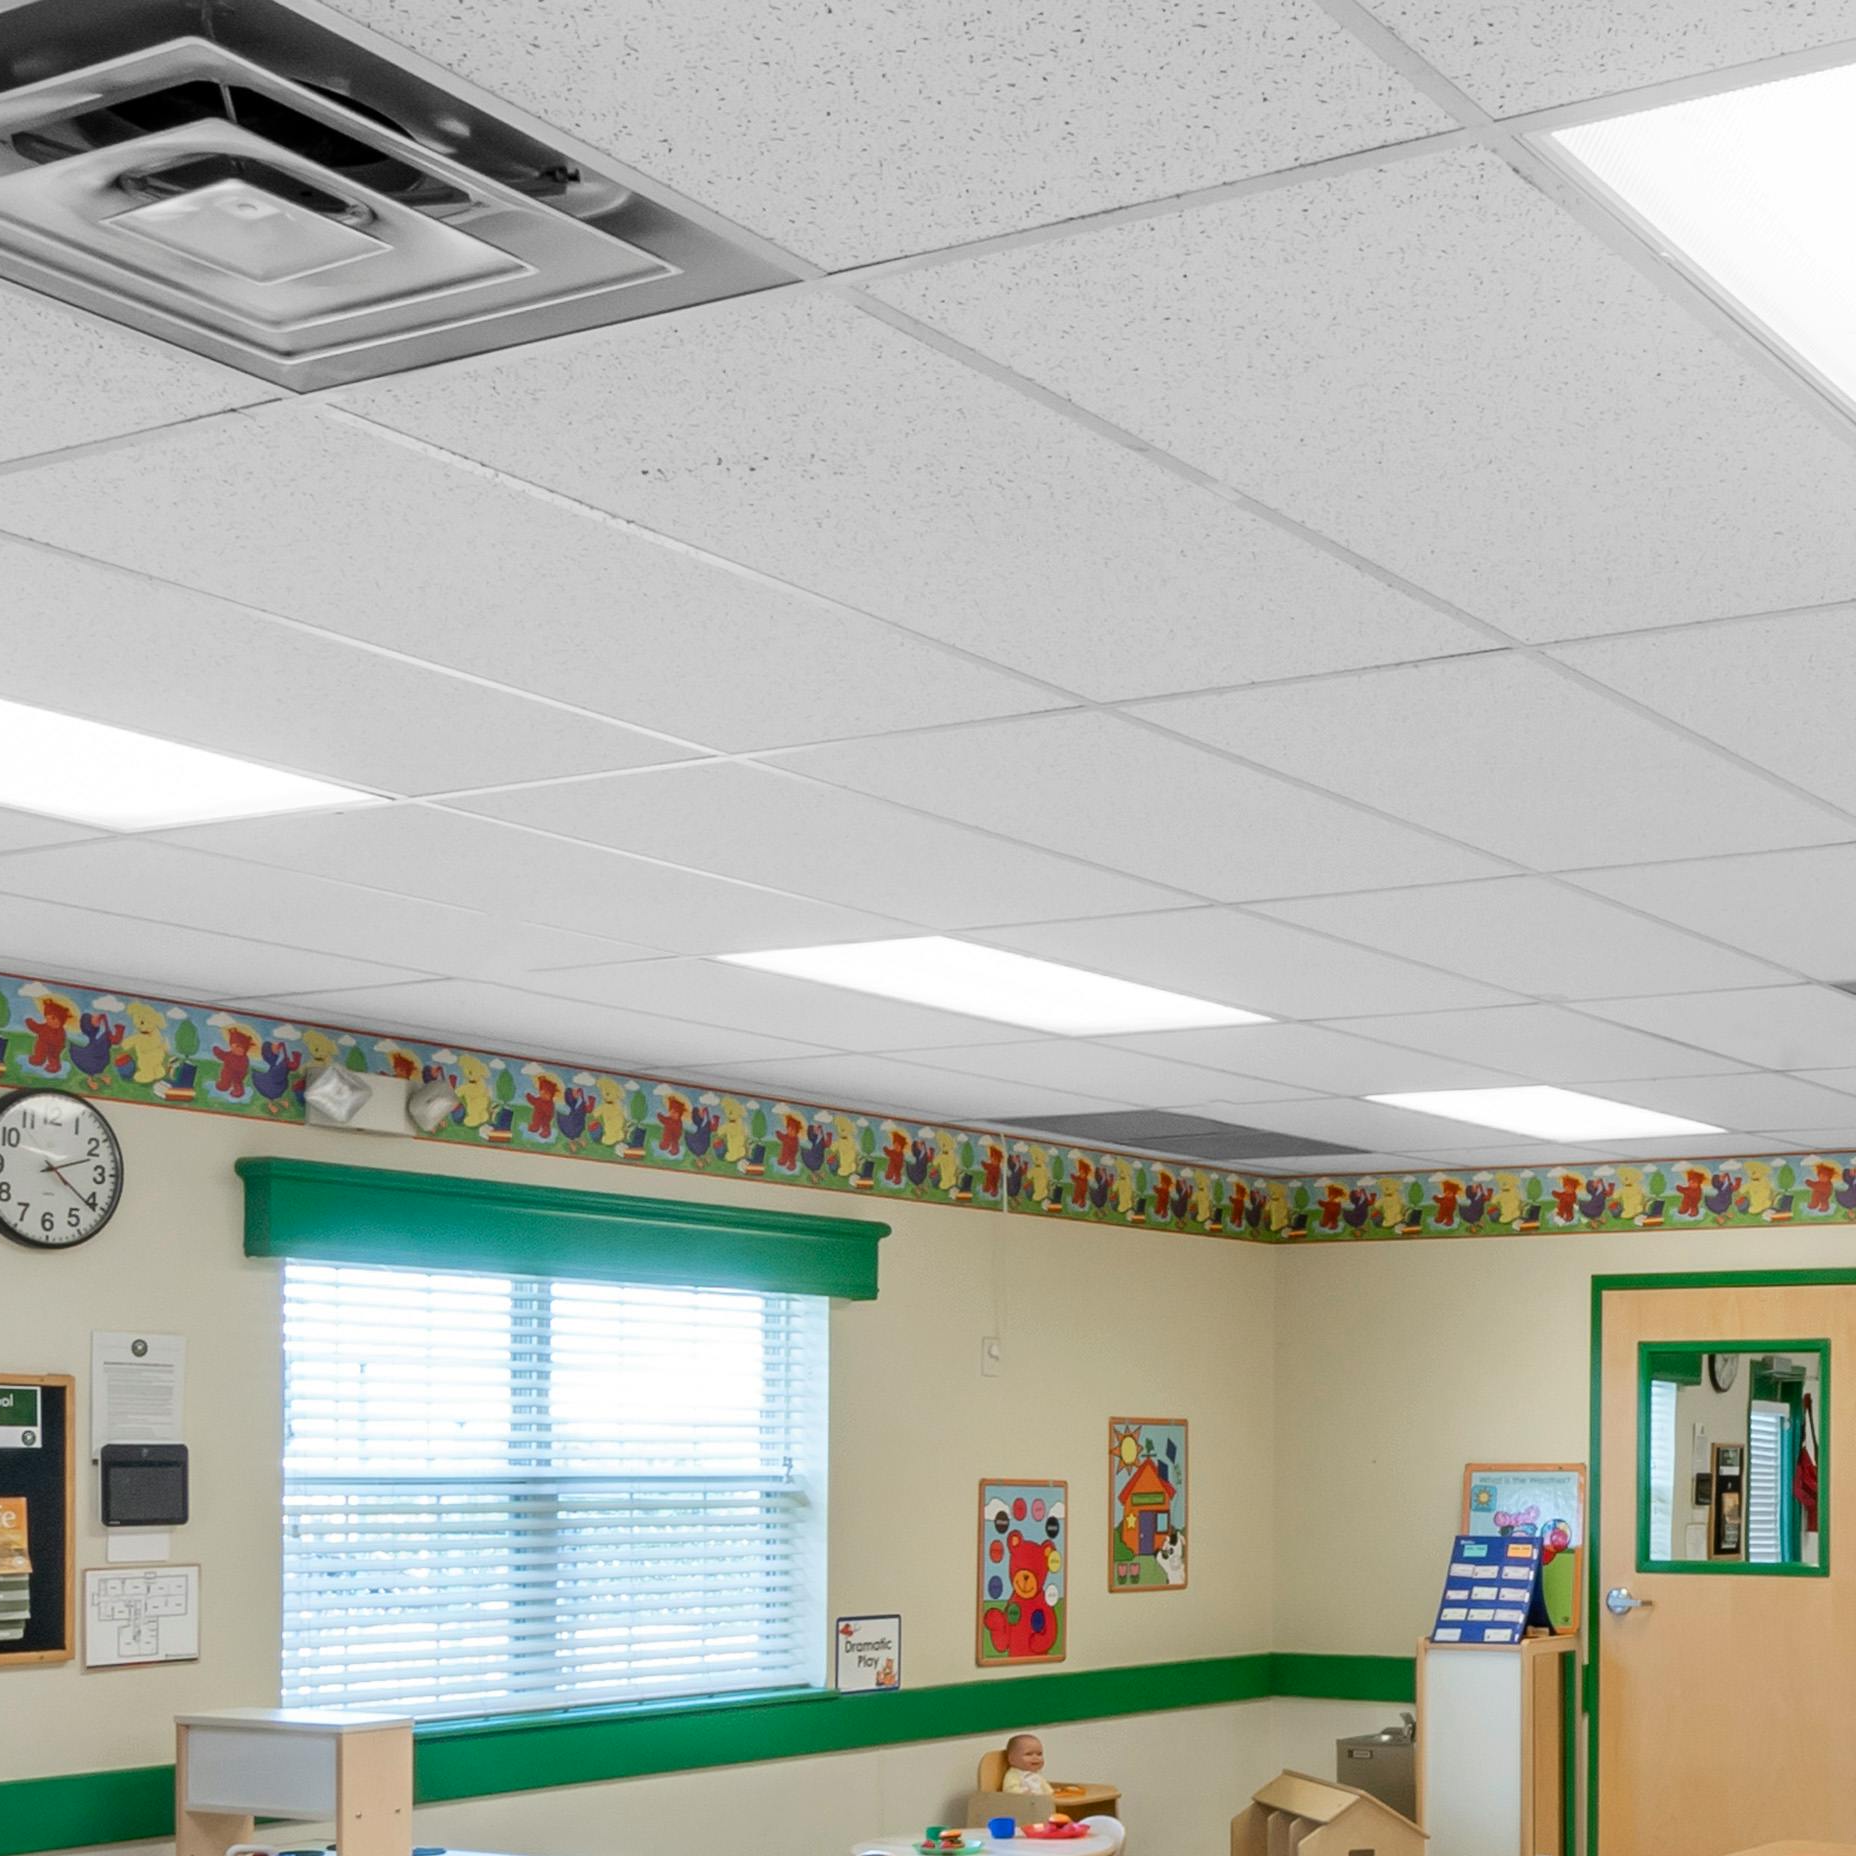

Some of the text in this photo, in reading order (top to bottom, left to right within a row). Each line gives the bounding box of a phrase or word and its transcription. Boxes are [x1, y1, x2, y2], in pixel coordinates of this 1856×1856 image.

[22, 1109, 35, 1130] 11
[74, 1116, 80, 1135] 1
[1, 1126, 21, 1148] 10
[87, 1137, 101, 1158] 2
[92, 1165, 106, 1185] 3
[85, 1191, 98, 1212] 4
[17, 1202, 30, 1222] 7
[41, 1212, 55, 1232] 6
[67, 1207, 81, 1228] 5
[845, 1637, 892, 1653] Dramatic
[857, 1655, 880, 1669] Play
